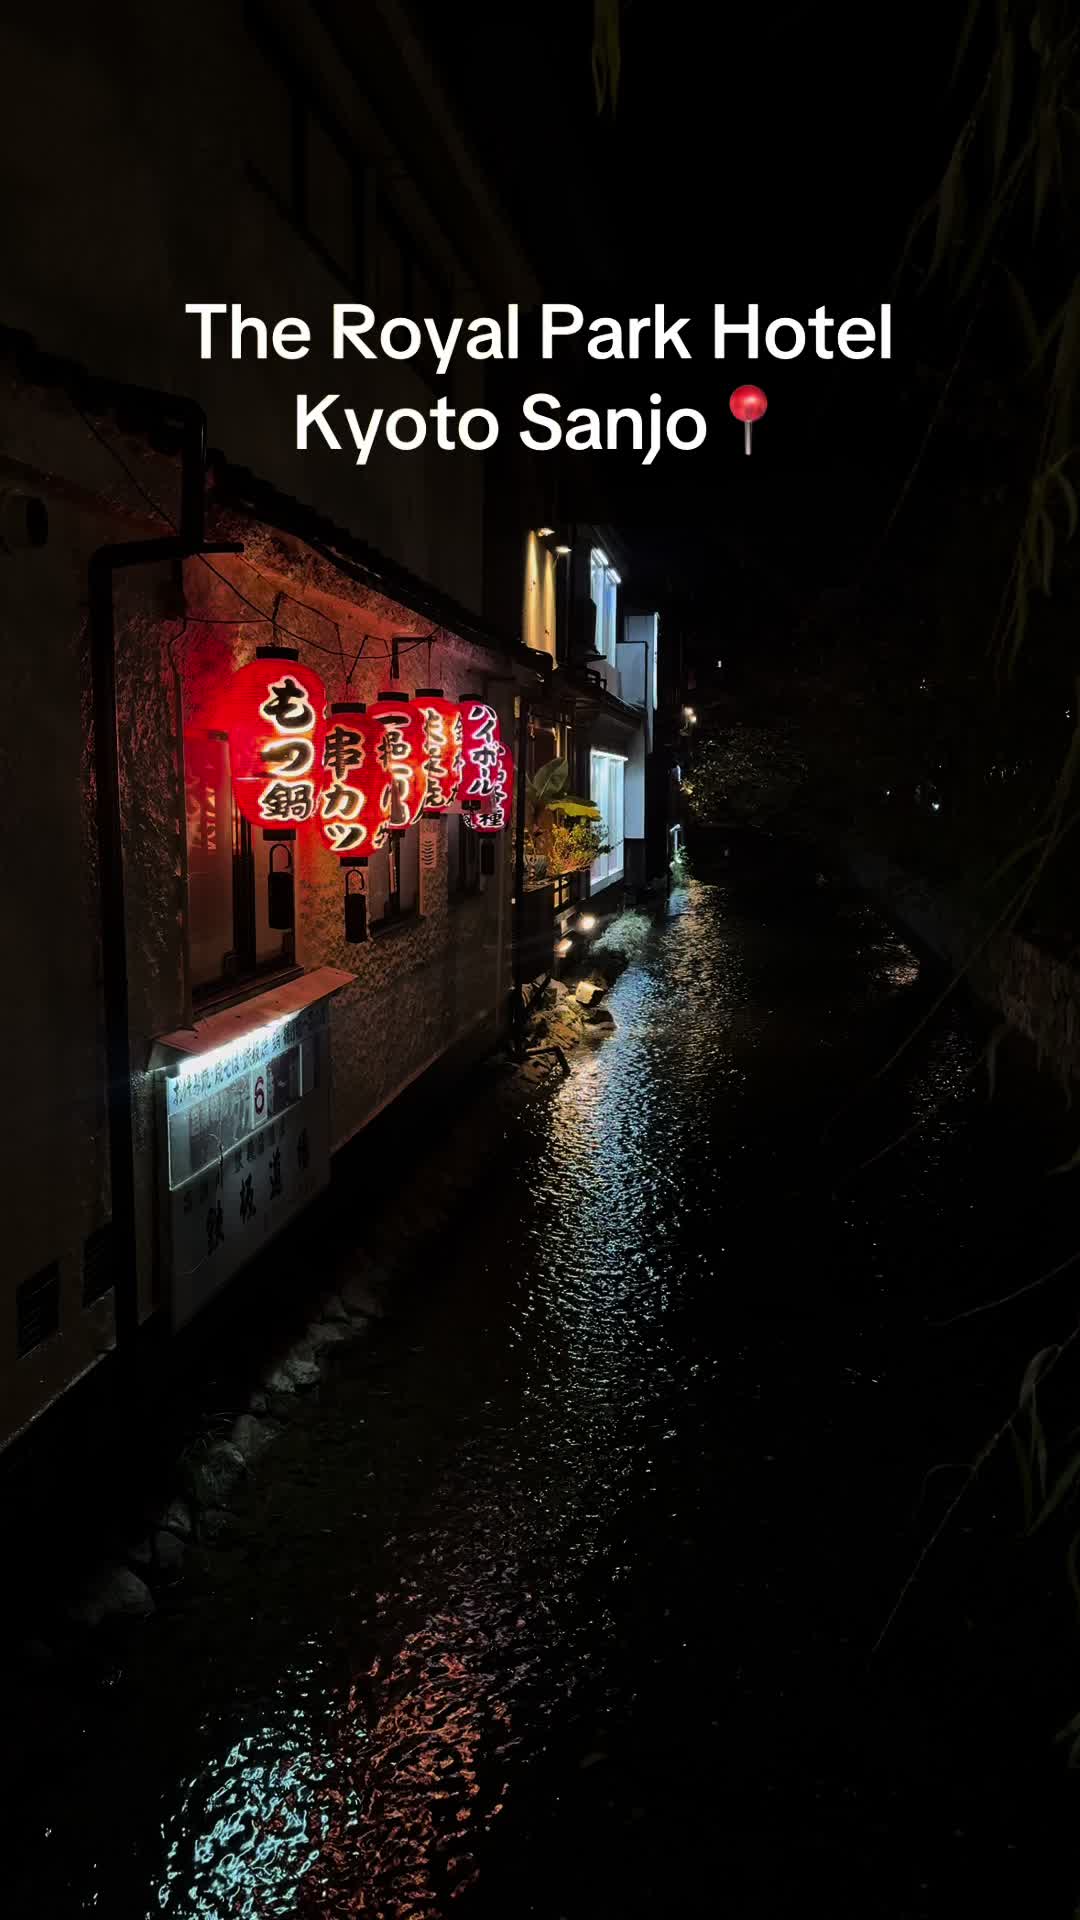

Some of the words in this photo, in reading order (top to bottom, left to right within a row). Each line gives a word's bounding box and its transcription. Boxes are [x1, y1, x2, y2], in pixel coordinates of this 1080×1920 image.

[260, 675, 317, 822] もつ鍋
[320, 725, 367, 851] 串カツ
[468, 704, 498, 795] ハイボール
[254, 1076, 265, 1115] 6
